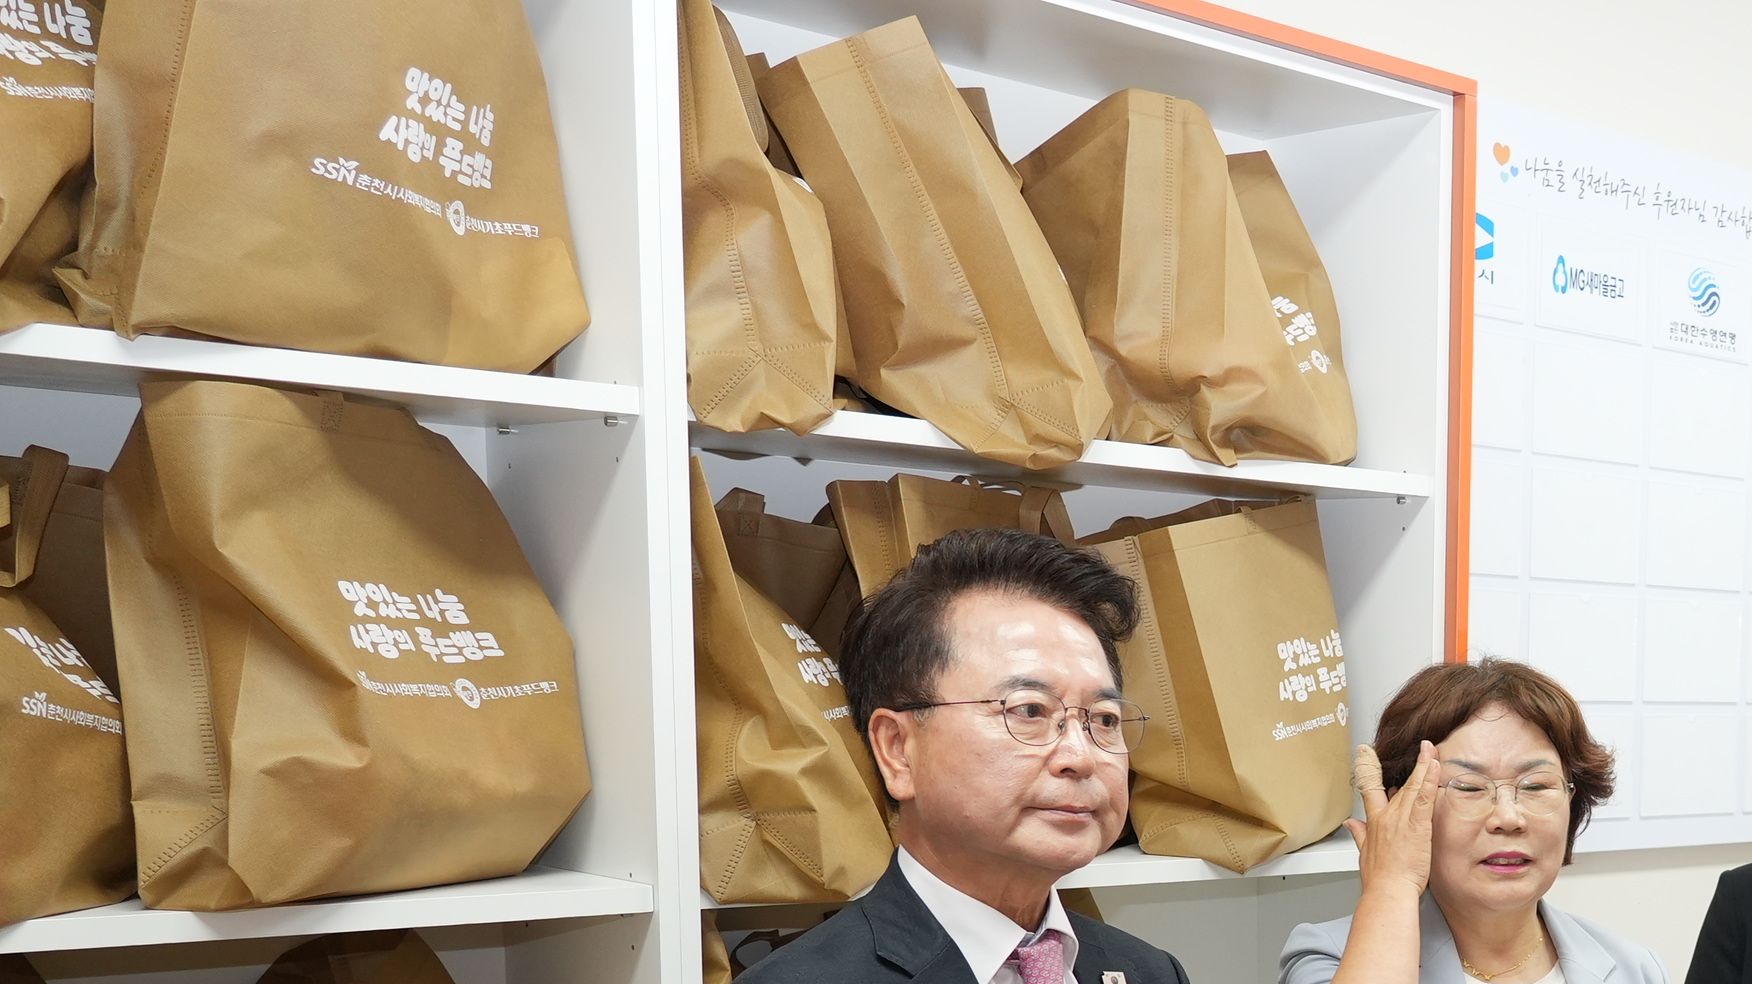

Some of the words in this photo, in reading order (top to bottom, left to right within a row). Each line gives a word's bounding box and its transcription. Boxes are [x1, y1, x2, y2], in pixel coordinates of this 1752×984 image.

[0, 0, 42, 34] 있는
[43, 0, 93, 45] 나눔
[0, 33, 56, 65] 랑의
[405, 66, 465, 131] 맛있는
[469, 104, 494, 147] 나눔
[310, 157, 356, 185] SSN
[379, 115, 436, 163] 사랑의
[439, 137, 493, 189] 푸드뱅크
[1525, 157, 1566, 193] 나눔을
[1571, 166, 1647, 209] 실천해주신
[1652, 183, 1708, 221] 후원자님
[1569, 266, 1625, 299] MG새마을금고
[337, 580, 420, 620] 맛있는
[417, 588, 470, 624] 나눔
[350, 624, 416, 659] 사랑의
[414, 627, 505, 664] 푸드뱅크
[1277, 637, 1321, 672] 맛있는
[1320, 629, 1344, 658] 나눔
[798, 657, 832, 687] 사랑의
[1279, 673, 1317, 702] 사랑의
[1316, 662, 1347, 694] 푸드뱅
[21, 696, 47, 719] SSN
